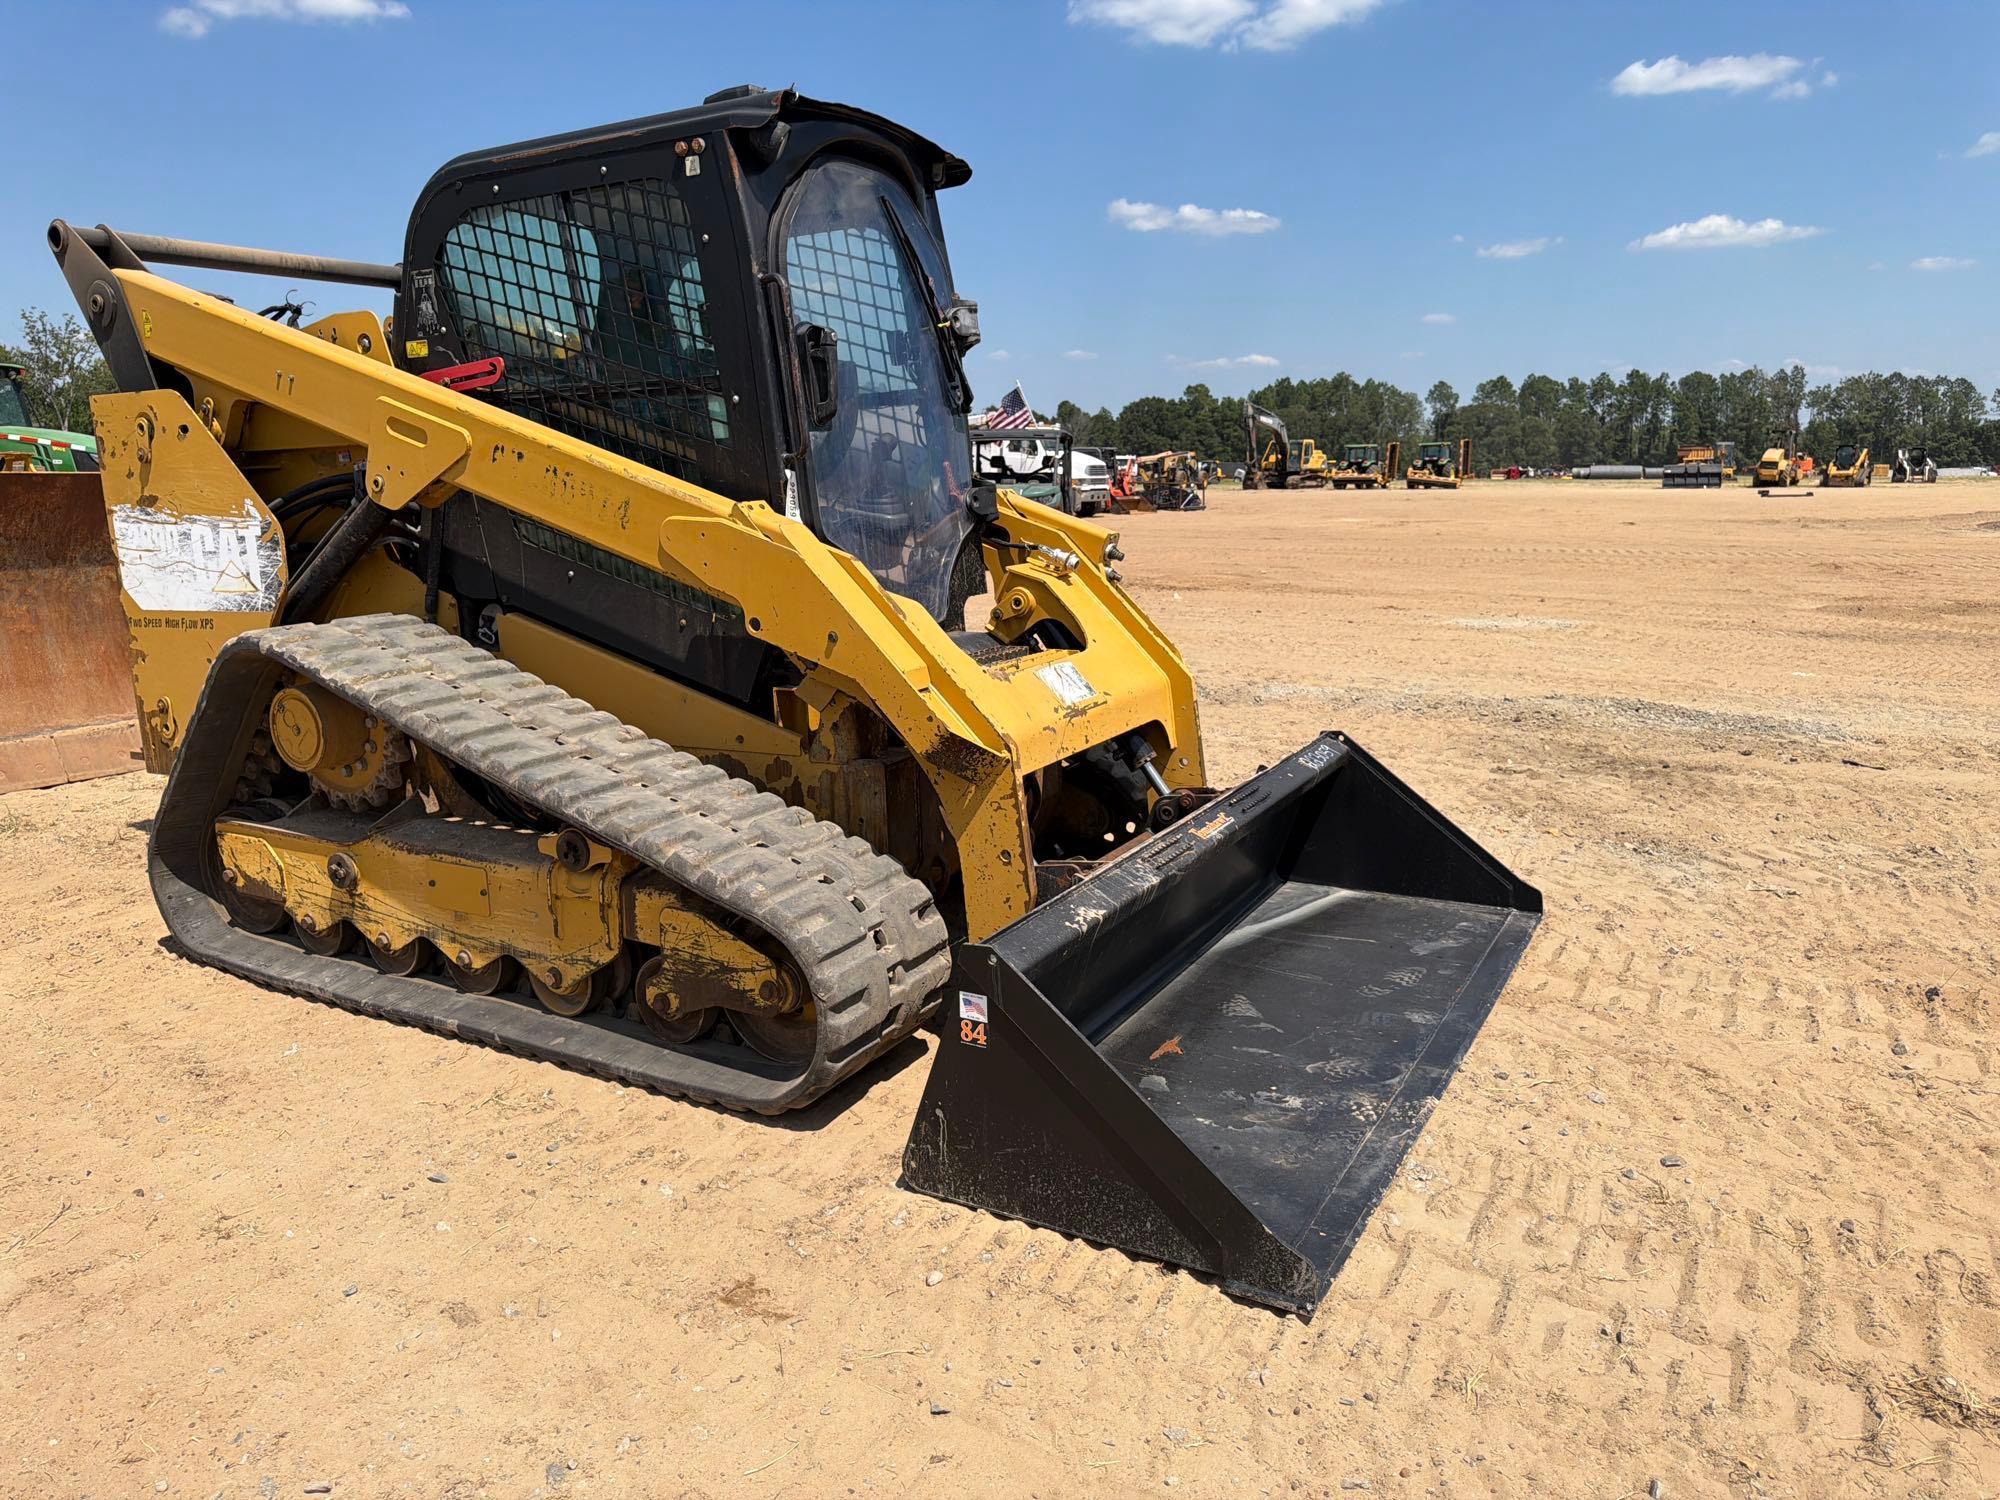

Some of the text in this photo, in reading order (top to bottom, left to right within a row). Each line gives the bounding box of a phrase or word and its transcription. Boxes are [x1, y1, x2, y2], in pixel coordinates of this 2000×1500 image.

[143, 616, 163, 629] SPEED
[165, 617, 180, 629] HIGH
[181, 617, 199, 630] FLOW
[200, 618, 214, 630] XPS
[960, 1019, 987, 1045] 84
